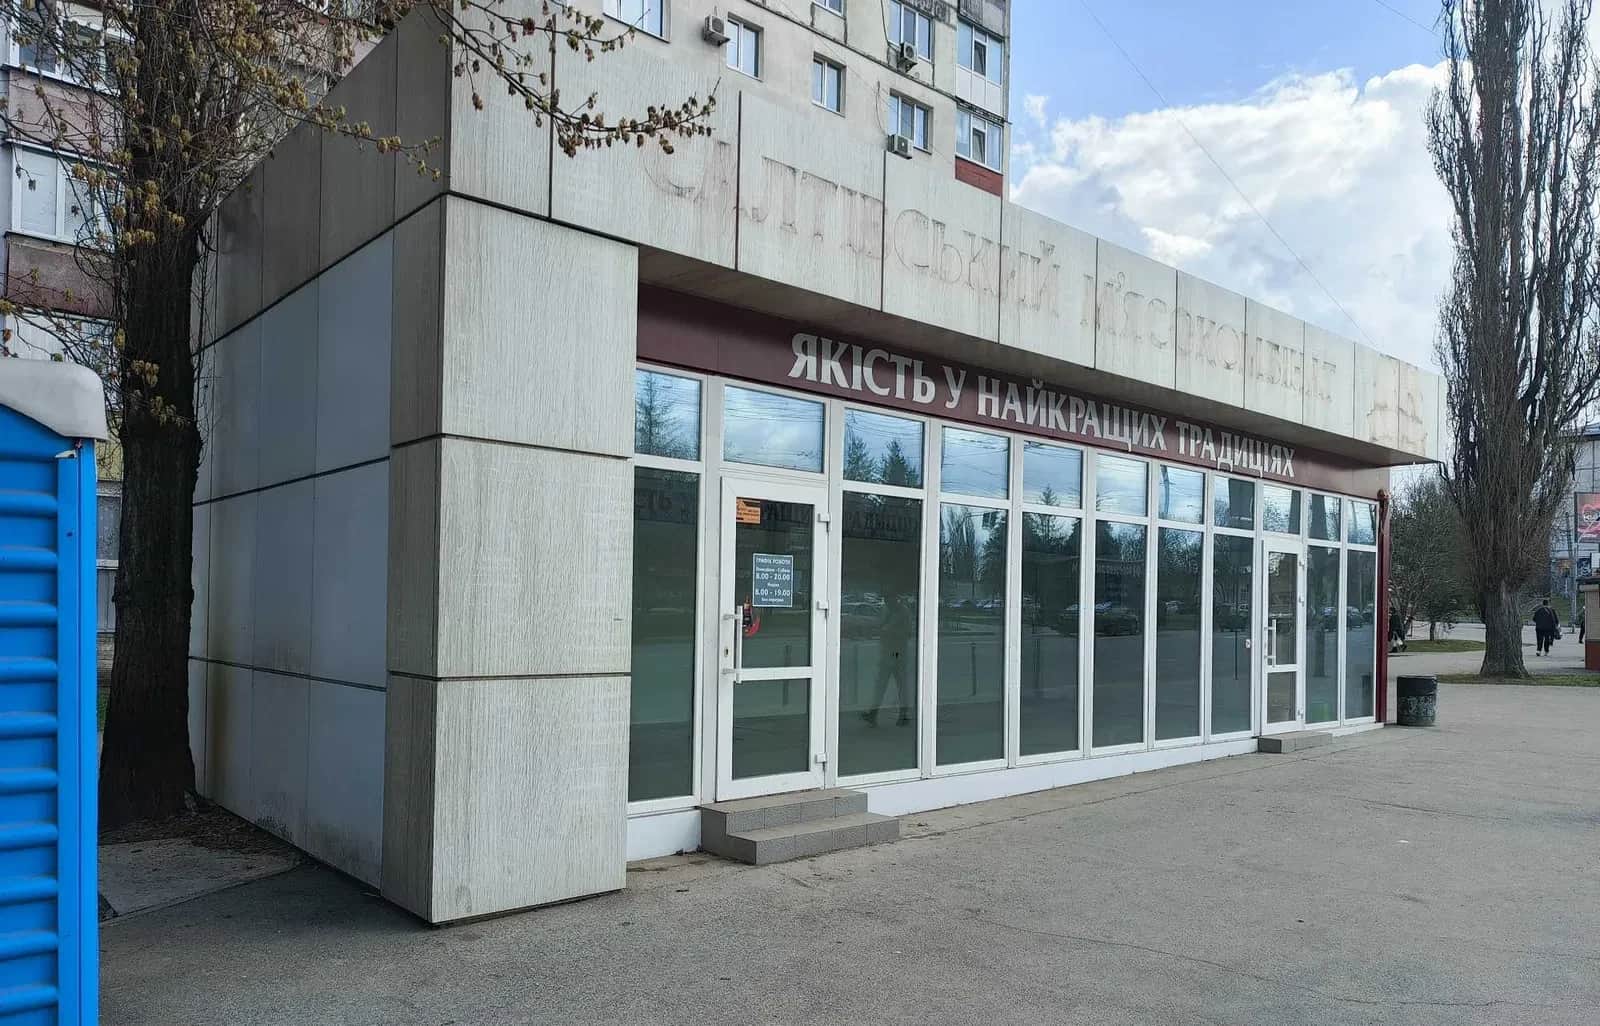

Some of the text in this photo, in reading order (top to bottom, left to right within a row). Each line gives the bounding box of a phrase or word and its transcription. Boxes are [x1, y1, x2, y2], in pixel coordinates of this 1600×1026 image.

[788, 333, 1296, 479] ЯКІСТЬ У НАЙКРАЩИХ ТРАДИЦІЯХ
